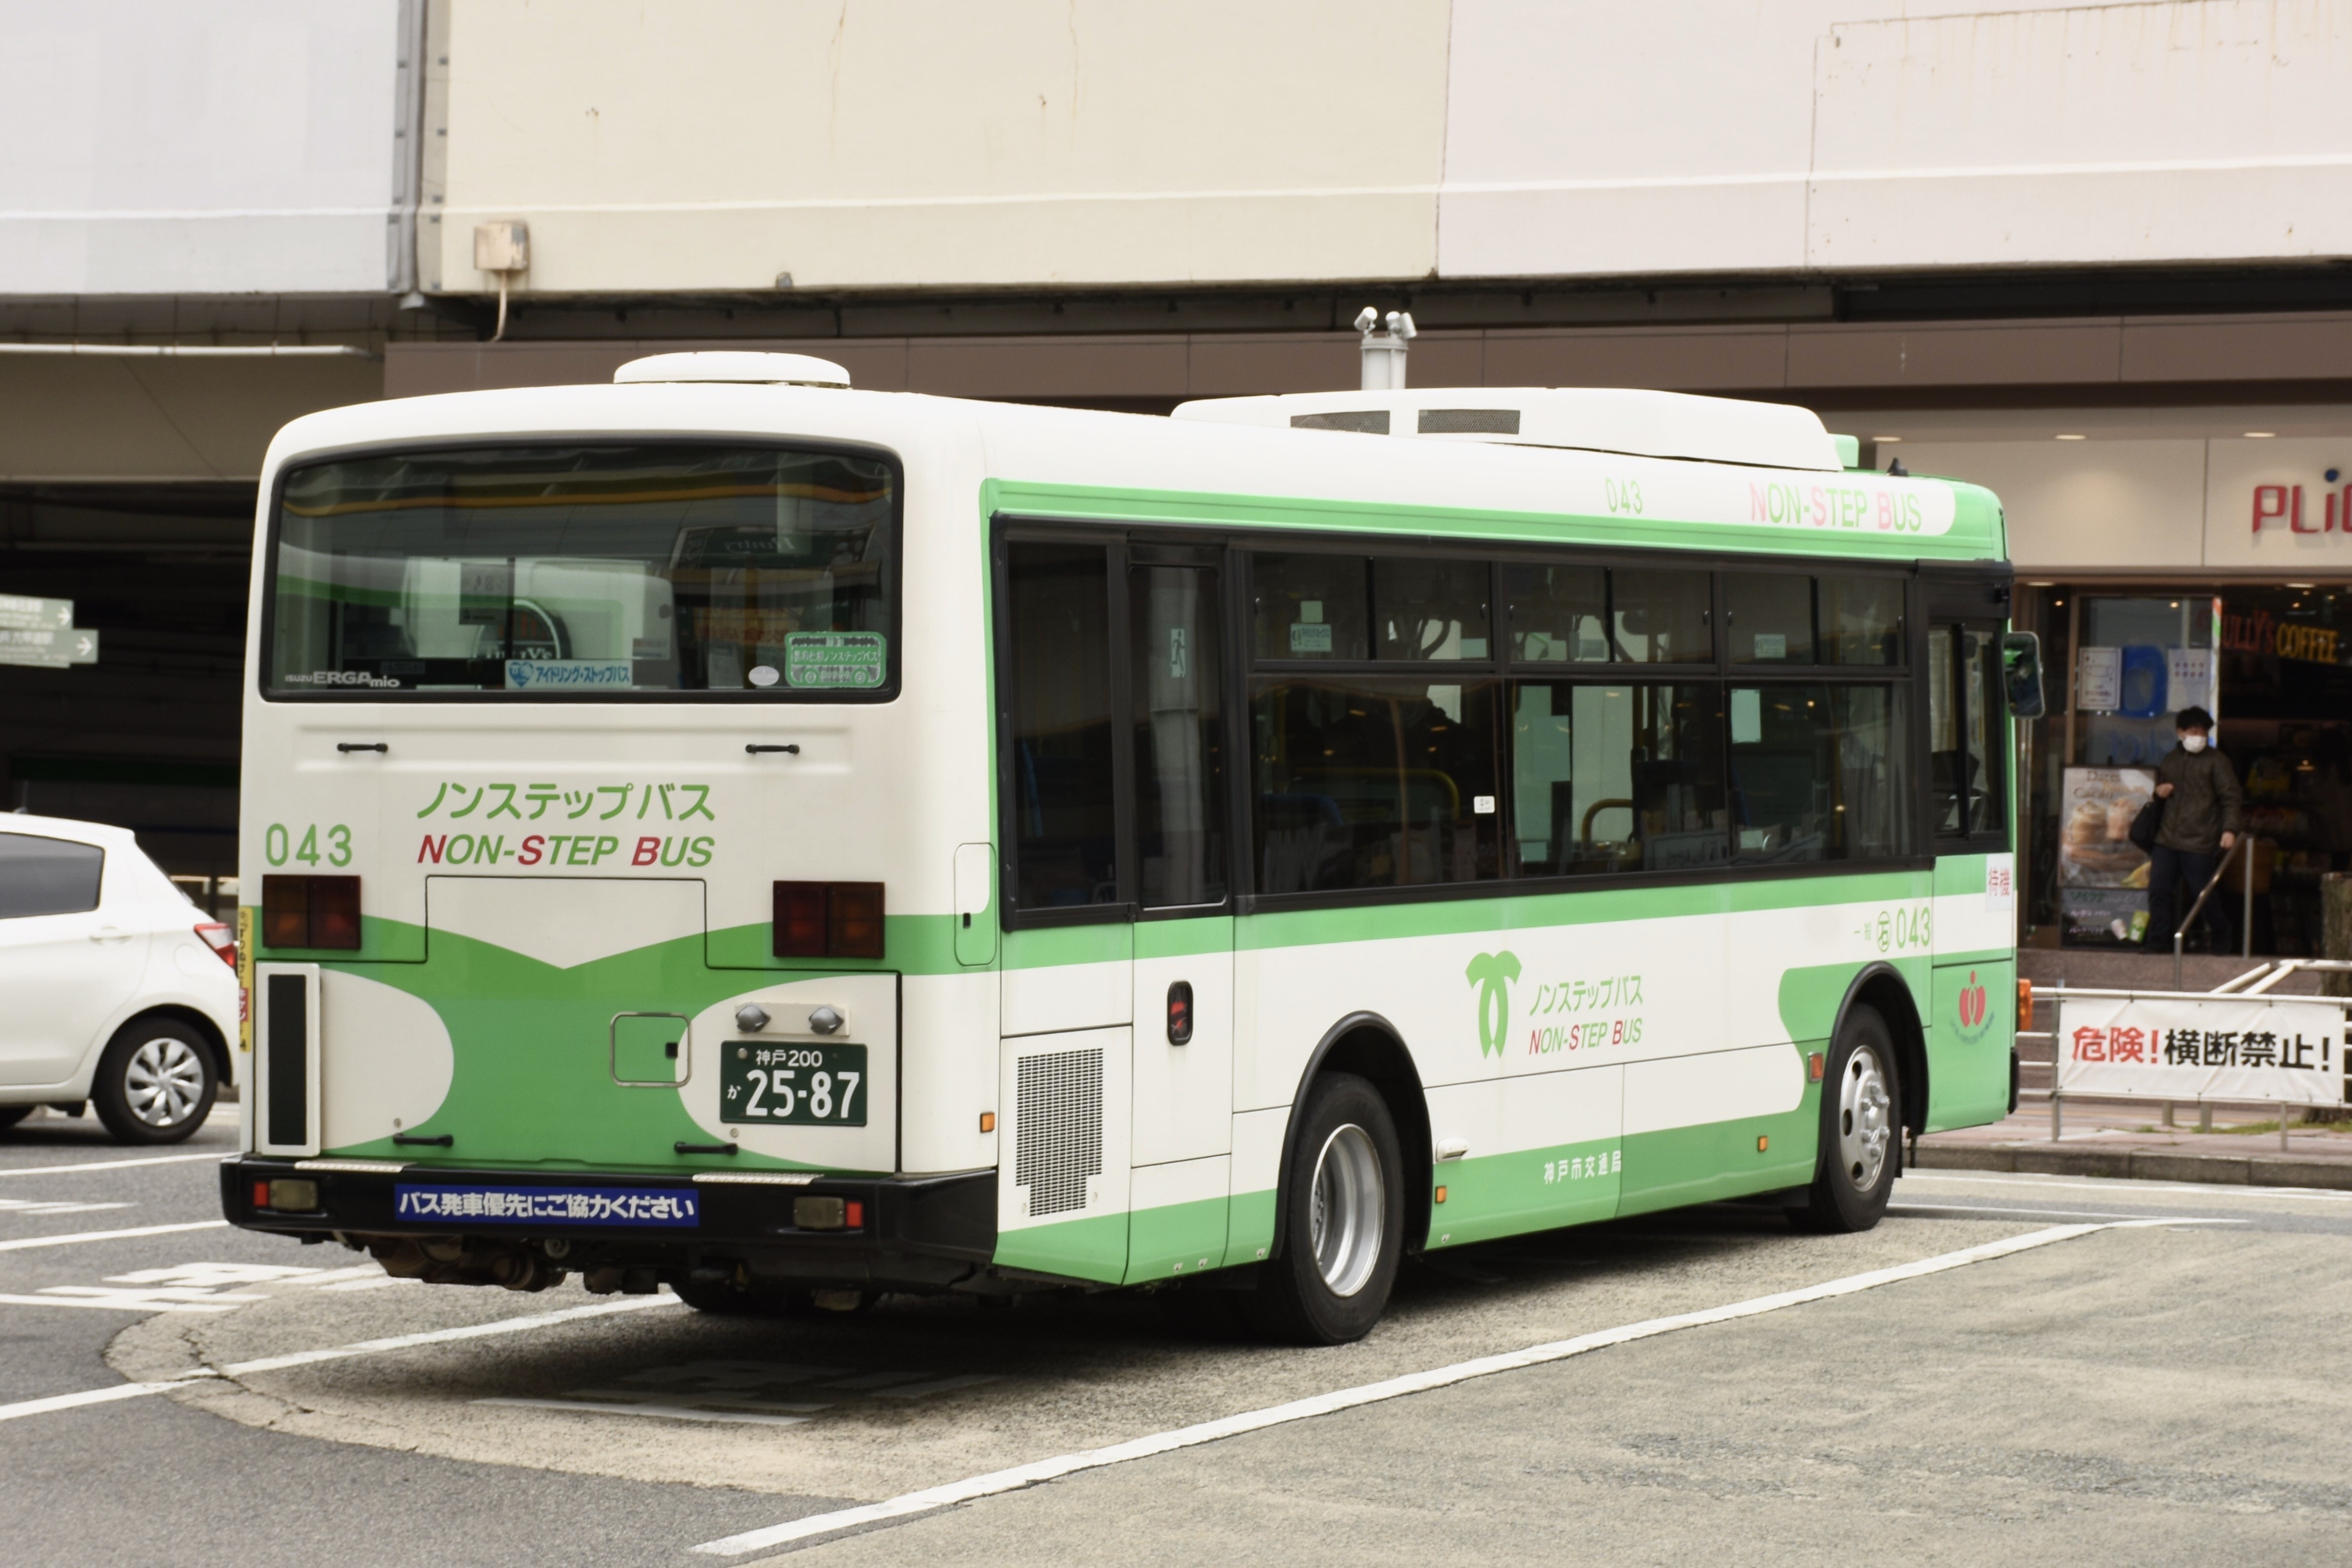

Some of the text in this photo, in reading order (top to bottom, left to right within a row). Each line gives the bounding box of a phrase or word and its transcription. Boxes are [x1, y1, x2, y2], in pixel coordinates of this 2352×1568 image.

[1605, 477, 1643, 514] 043
[1749, 481, 1922, 532] NON-STEP BUS
[2276, 622, 2339, 664] COFFEE
[536, 666, 630, 683] アイドリング・ストップバス
[417, 782, 715, 821] ノンステップバス
[265, 823, 353, 867] 043
[417, 834, 715, 867] NON-STEP BUS
[1897, 906, 1930, 949] 043
[1529, 975, 1643, 1017] ノンステップバス
[1528, 1017, 1643, 1056] NON-STEP BUS
[2072, 1026, 2330, 1071] 危険!横断禁止!
[727, 1069, 860, 1119] か 25-87
[1544, 1149, 1622, 1185] 神戸市交通局
[399, 1191, 695, 1219] バス発車優先にご協力ください
